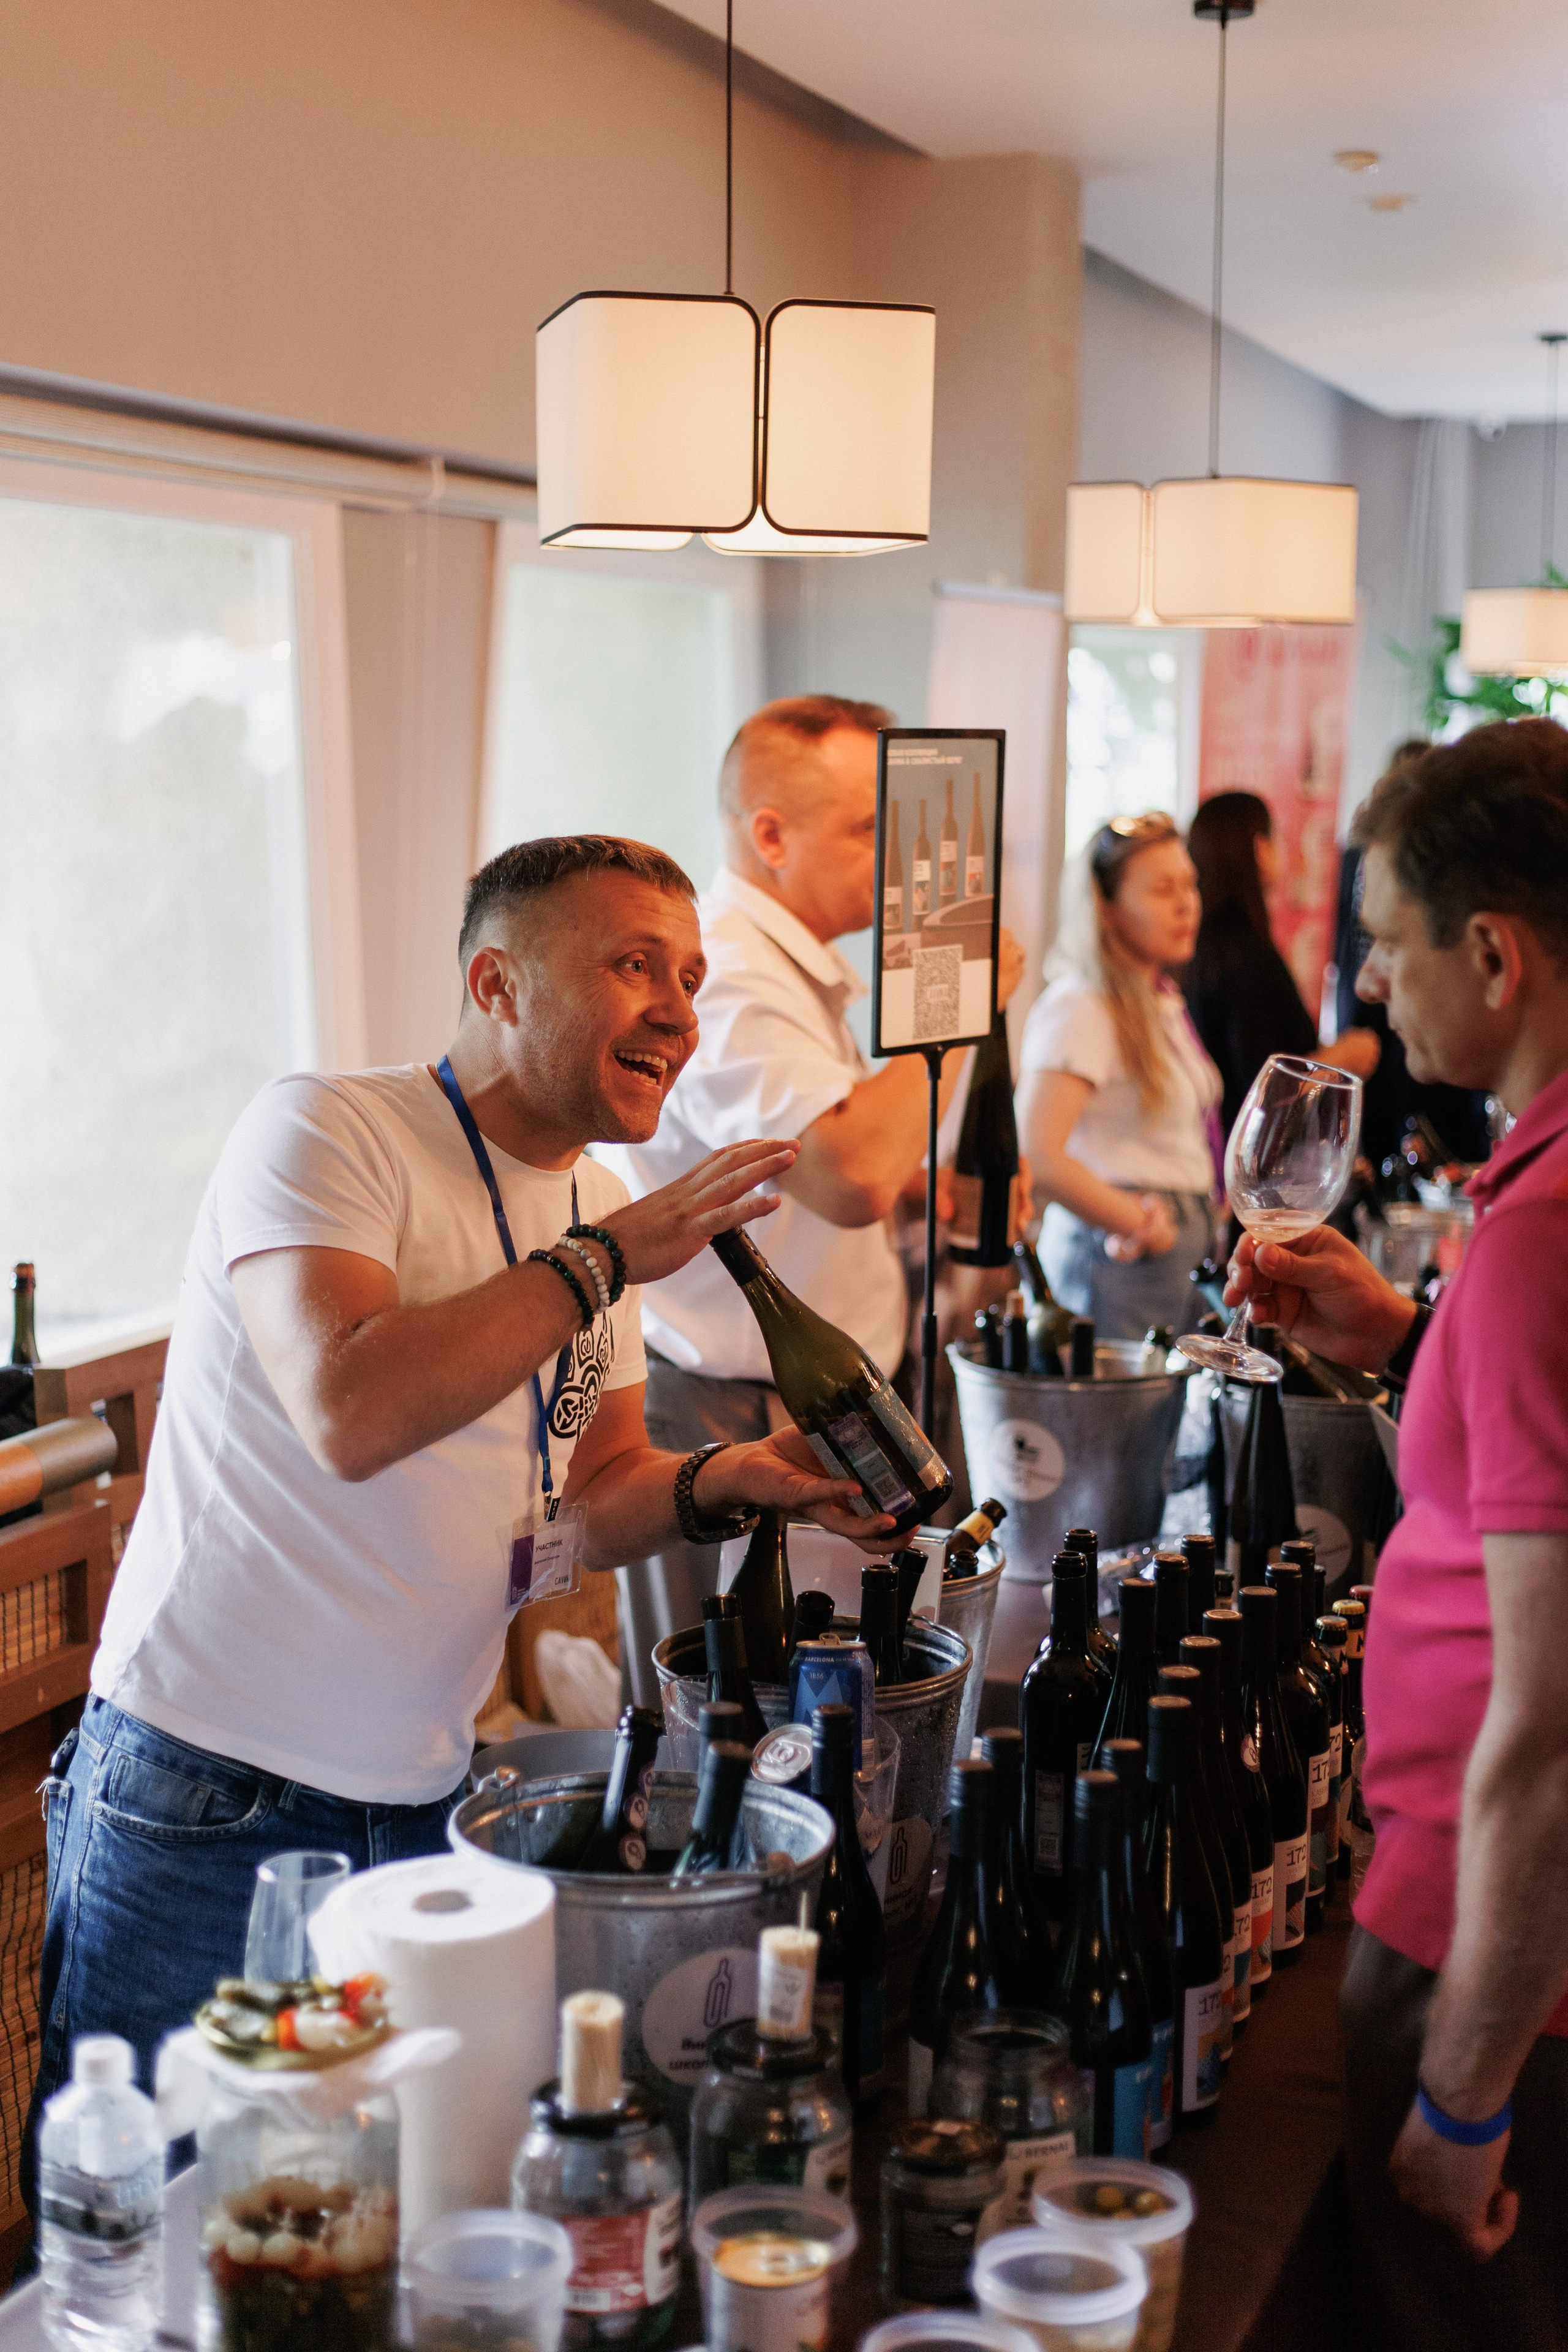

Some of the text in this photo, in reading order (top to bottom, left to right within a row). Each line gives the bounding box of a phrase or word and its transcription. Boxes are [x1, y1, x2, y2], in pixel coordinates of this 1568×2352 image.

[535, 1539, 563, 1553] УЧАСТНИК
[1329, 1732, 1341, 1752] 72
[1312, 1760, 1330, 1783] 17
[1287, 1844, 1306, 1866] 172
[1251, 1876, 1272, 1899] 172
[1234, 1914, 1250, 1937] 72
